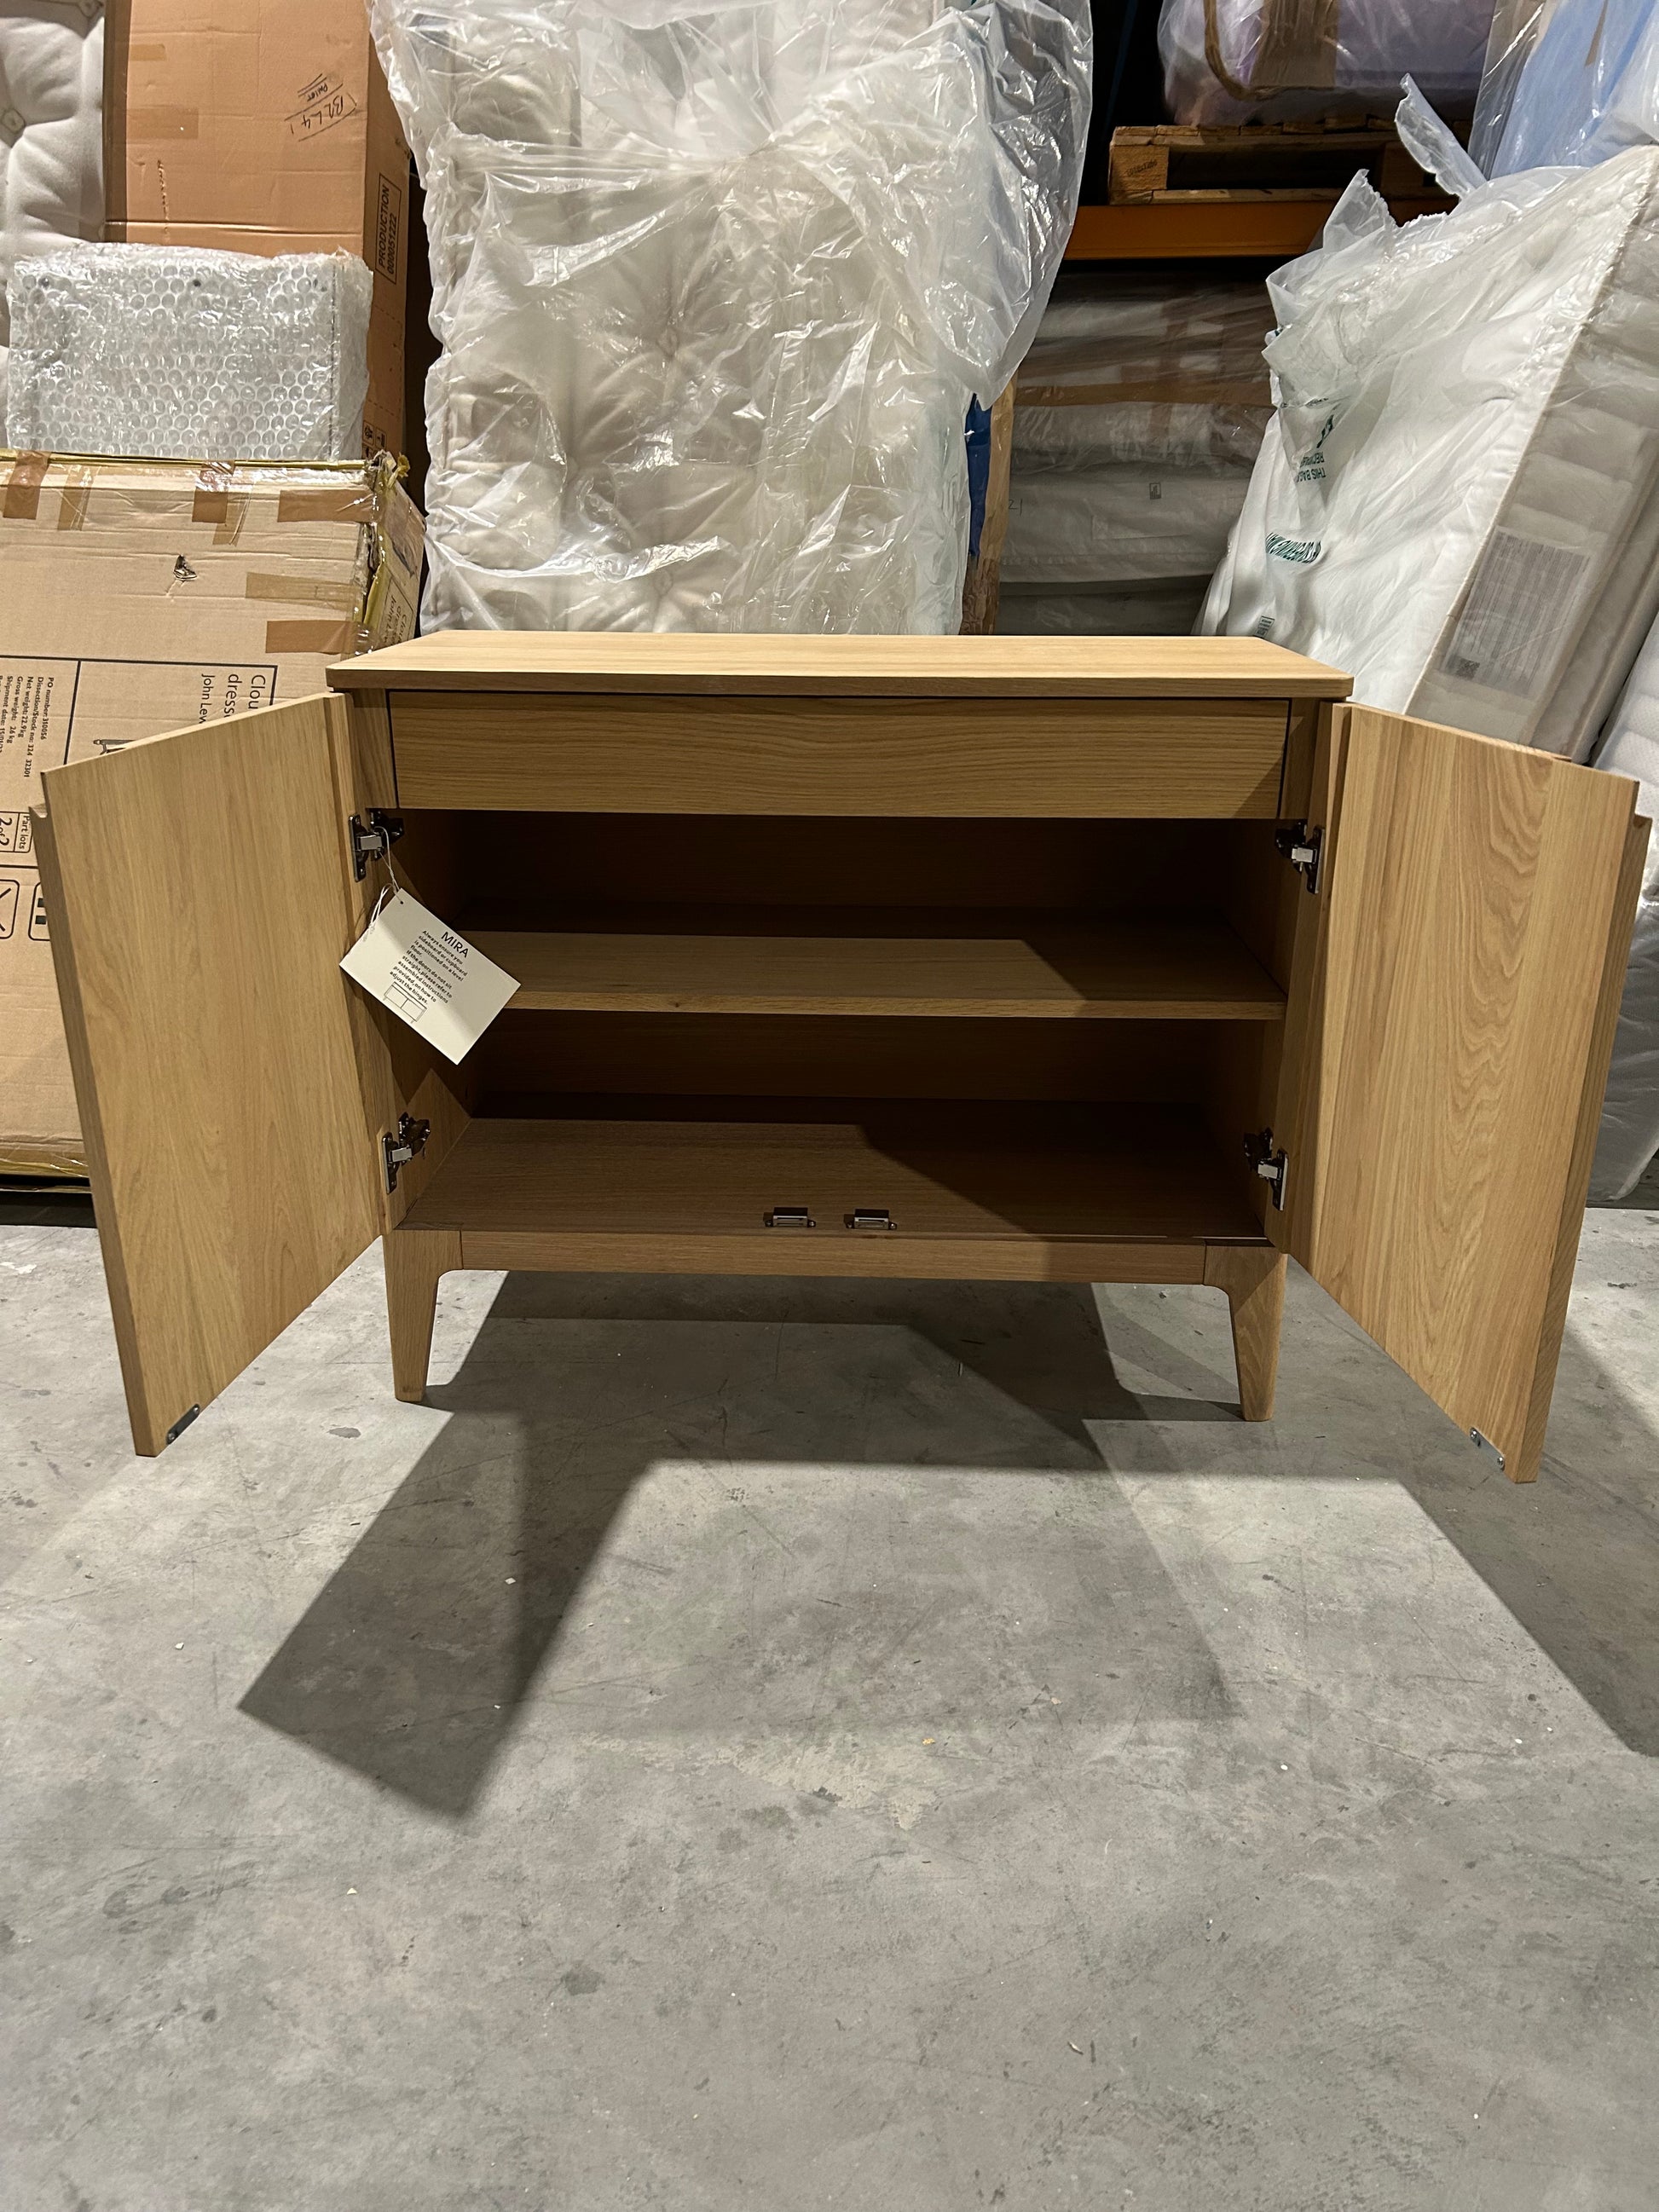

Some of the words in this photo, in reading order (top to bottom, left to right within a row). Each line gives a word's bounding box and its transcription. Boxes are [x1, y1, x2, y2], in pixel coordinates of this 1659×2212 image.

[378, 186, 390, 268] PRODUCTION
[3, 676, 13, 707] Shipment
[14, 676, 23, 696] Gross
[26, 676, 34, 690] Net
[47, 677, 55, 688] PO
[201, 673, 216, 700] John
[11, 697, 20, 721] weight:
[22, 690, 31, 715] weight:
[31, 676, 44, 731] Dissection/Stock
[41, 718, 49, 740] 310056
[24, 759, 32, 777] 32301
[21, 816, 31, 832] Part
[19, 835, 28, 850] lots
[422, 930, 439, 944] Always
[438, 944, 454, 956] ensure
[441, 932, 469, 957] MIRA
[418, 944, 442, 964] positioned
[452, 970, 463, 980] level
[418, 960, 431, 972] doors
[419, 935, 441, 954] sideboard
[445, 957, 467, 976] cupboard
[390, 970, 404, 984] adjust
[398, 960, 422, 981] assembled
[421, 979, 448, 1002] instructions
[420, 971, 436, 984] please
[436, 982, 447, 993] refer
[420, 987, 431, 997] how
